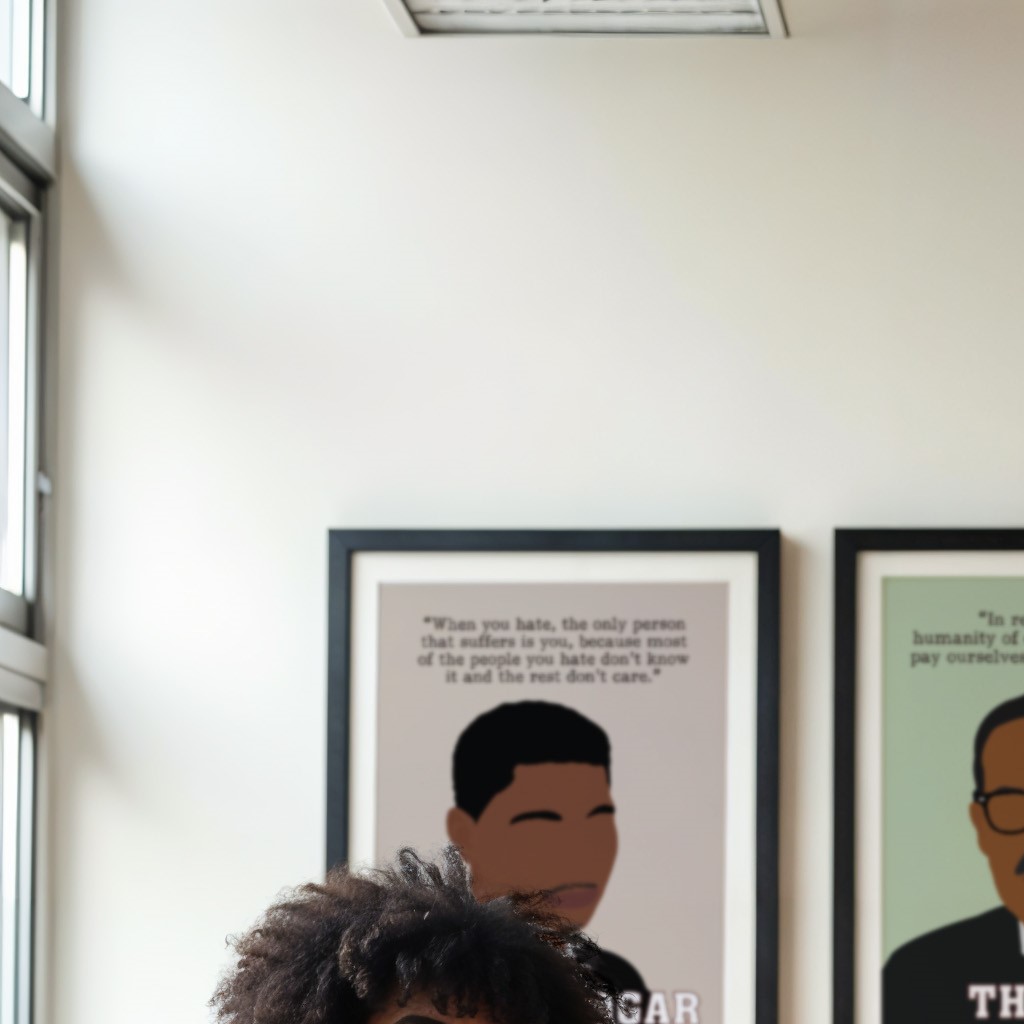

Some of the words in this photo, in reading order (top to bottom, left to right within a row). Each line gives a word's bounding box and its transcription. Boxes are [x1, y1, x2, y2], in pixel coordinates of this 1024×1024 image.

[423, 615, 476, 631] "When
[482, 618, 510, 635] you
[516, 615, 556, 633] hate,
[562, 616, 588, 631] the
[593, 616, 627, 635] only
[633, 619, 686, 635] person
[978, 610, 1004, 627] "In
[421, 634, 454, 649] that
[459, 634, 515, 649] suffers
[521, 634, 534, 649] is
[540, 637, 573, 652] you,
[579, 634, 641, 649] because
[647, 635, 687, 649] most
[912, 630, 996, 648] humanity
[1002, 630, 1020, 646] of
[417, 651, 434, 666] of
[439, 652, 465, 666] the
[470, 652, 521, 670] people
[526, 654, 554, 669] you
[560, 652, 595, 666] hate
[600, 651, 641, 666] don't
[647, 652, 690, 666] know
[910, 651, 940, 668] pay
[445, 669, 458, 683] it
[463, 669, 492, 683] and
[498, 669, 524, 683] the
[530, 670, 561, 683] rest
[566, 668, 607, 683] don't
[612, 669, 661, 683] care."
